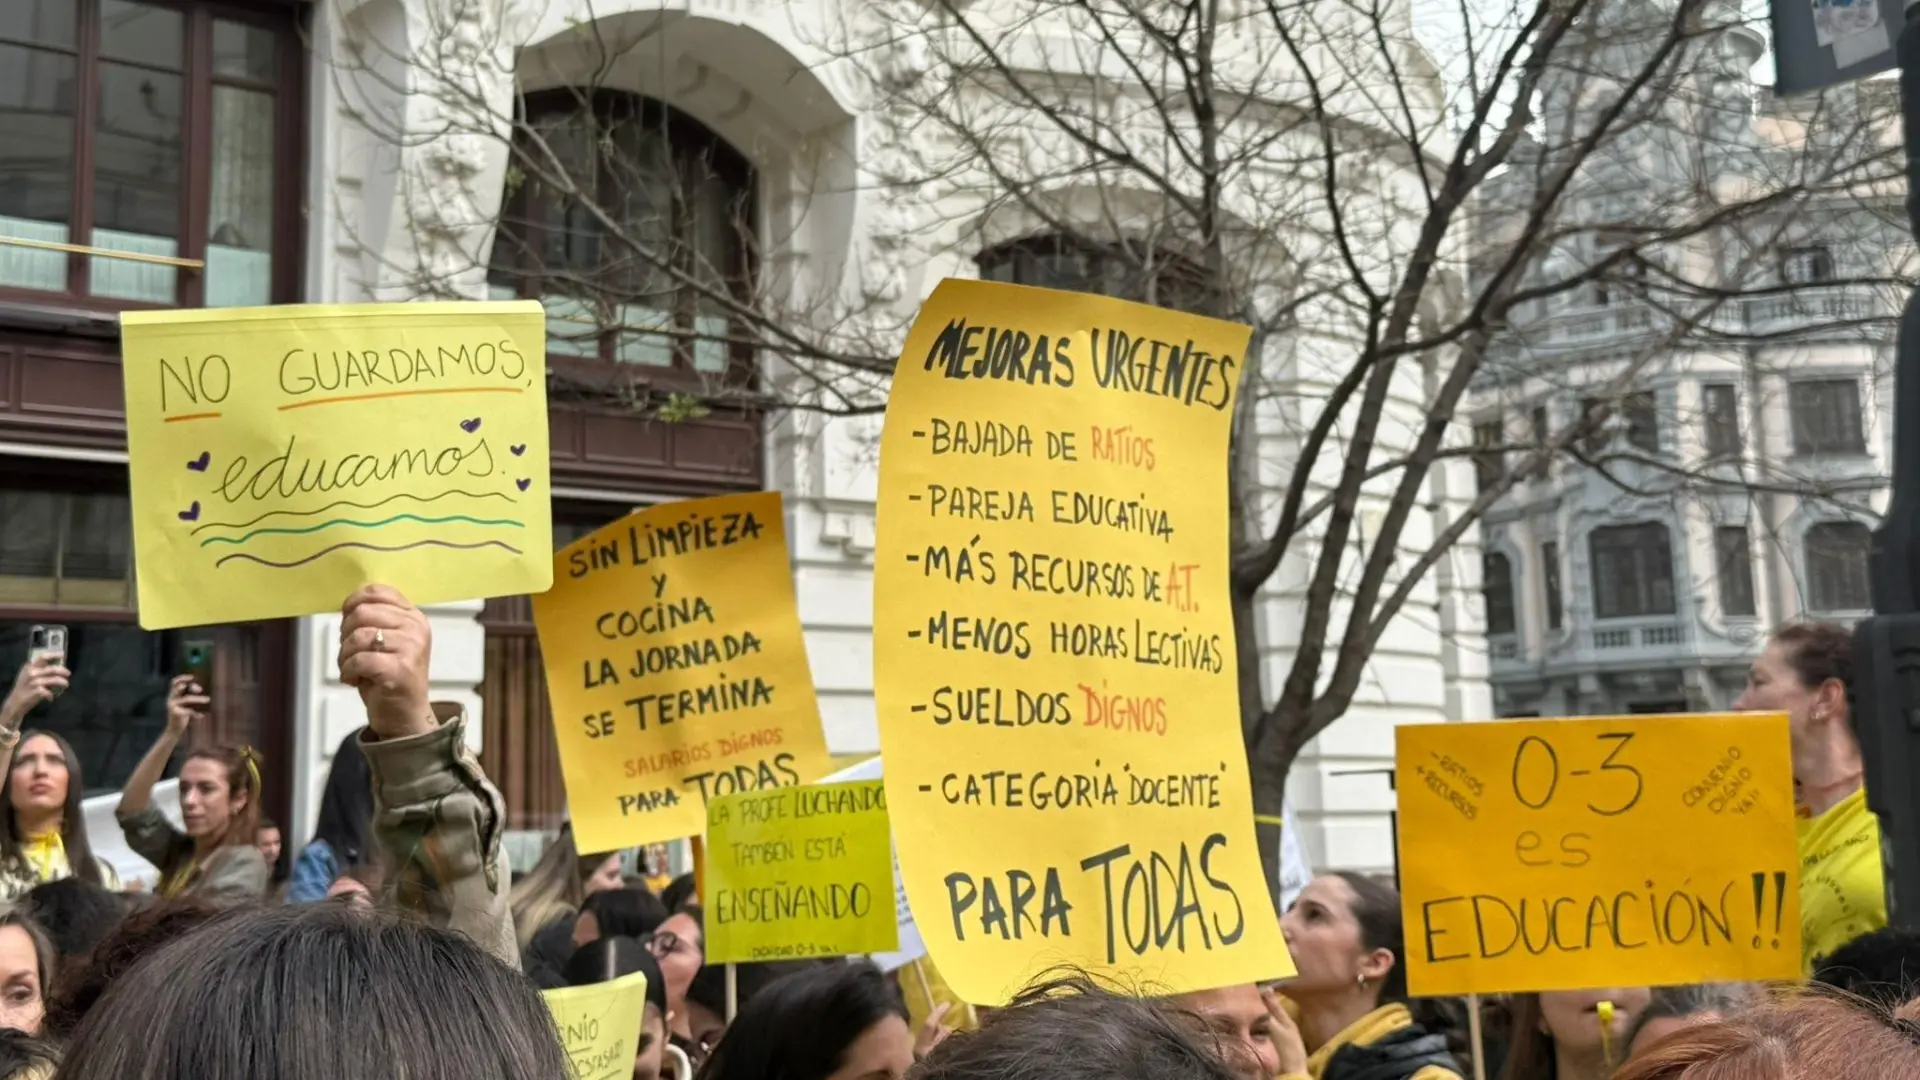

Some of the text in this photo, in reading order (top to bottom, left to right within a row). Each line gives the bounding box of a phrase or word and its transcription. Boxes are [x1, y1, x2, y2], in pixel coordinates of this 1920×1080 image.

[160, 340, 532, 411] NO GUARDAMOS,
[923, 316, 1236, 411] MEJORAS URGENTES
[212, 435, 505, 502] educamos.
[1046, 430, 1078, 462] DE
[652, 573, 667, 598] Y
[1008, 550, 1134, 599] RECURSOS
[1141, 566, 1162, 603] DE
[1165, 561, 1201, 613] A.T.
[584, 631, 761, 689] LA JORNADA
[1050, 621, 1128, 659] HORAS
[583, 711, 615, 739] SE
[617, 752, 800, 815] PARA TODAS
[1511, 732, 1644, 816] 0-3
[709, 804, 730, 826] LA
[739, 794, 787, 826] PROFE
[804, 831, 847, 861] ESTÁ
[1515, 829, 1592, 867] es
[716, 880, 871, 925] ENSEÑANDO
[944, 866, 1073, 941] PARA
[1080, 832, 1244, 964] TODAS
